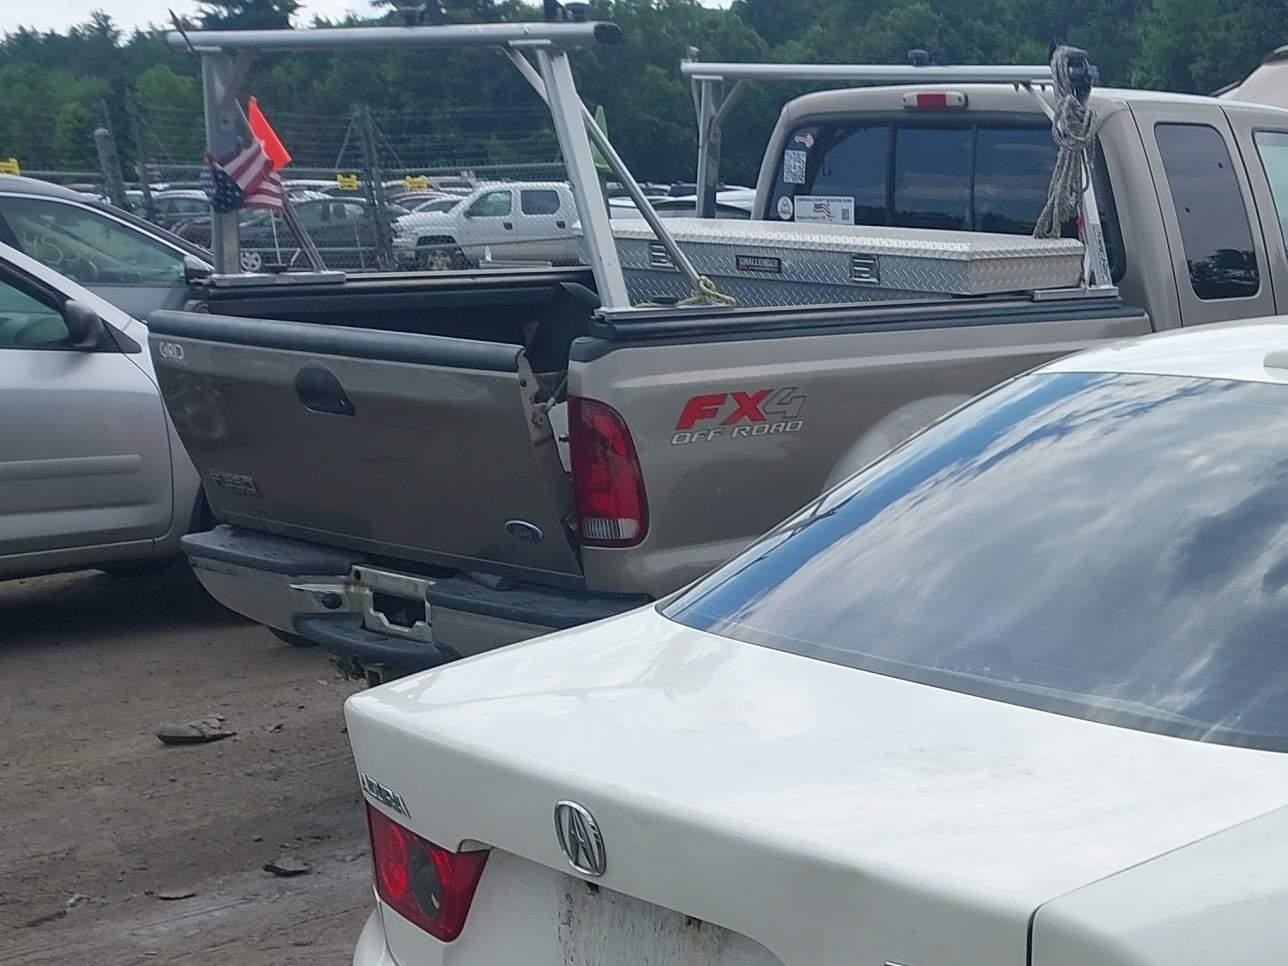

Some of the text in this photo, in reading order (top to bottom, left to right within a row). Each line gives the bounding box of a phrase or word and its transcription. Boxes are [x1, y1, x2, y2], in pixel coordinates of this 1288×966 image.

[674, 386, 808, 432] FX4
[670, 419, 804, 445] OFF ROAD
